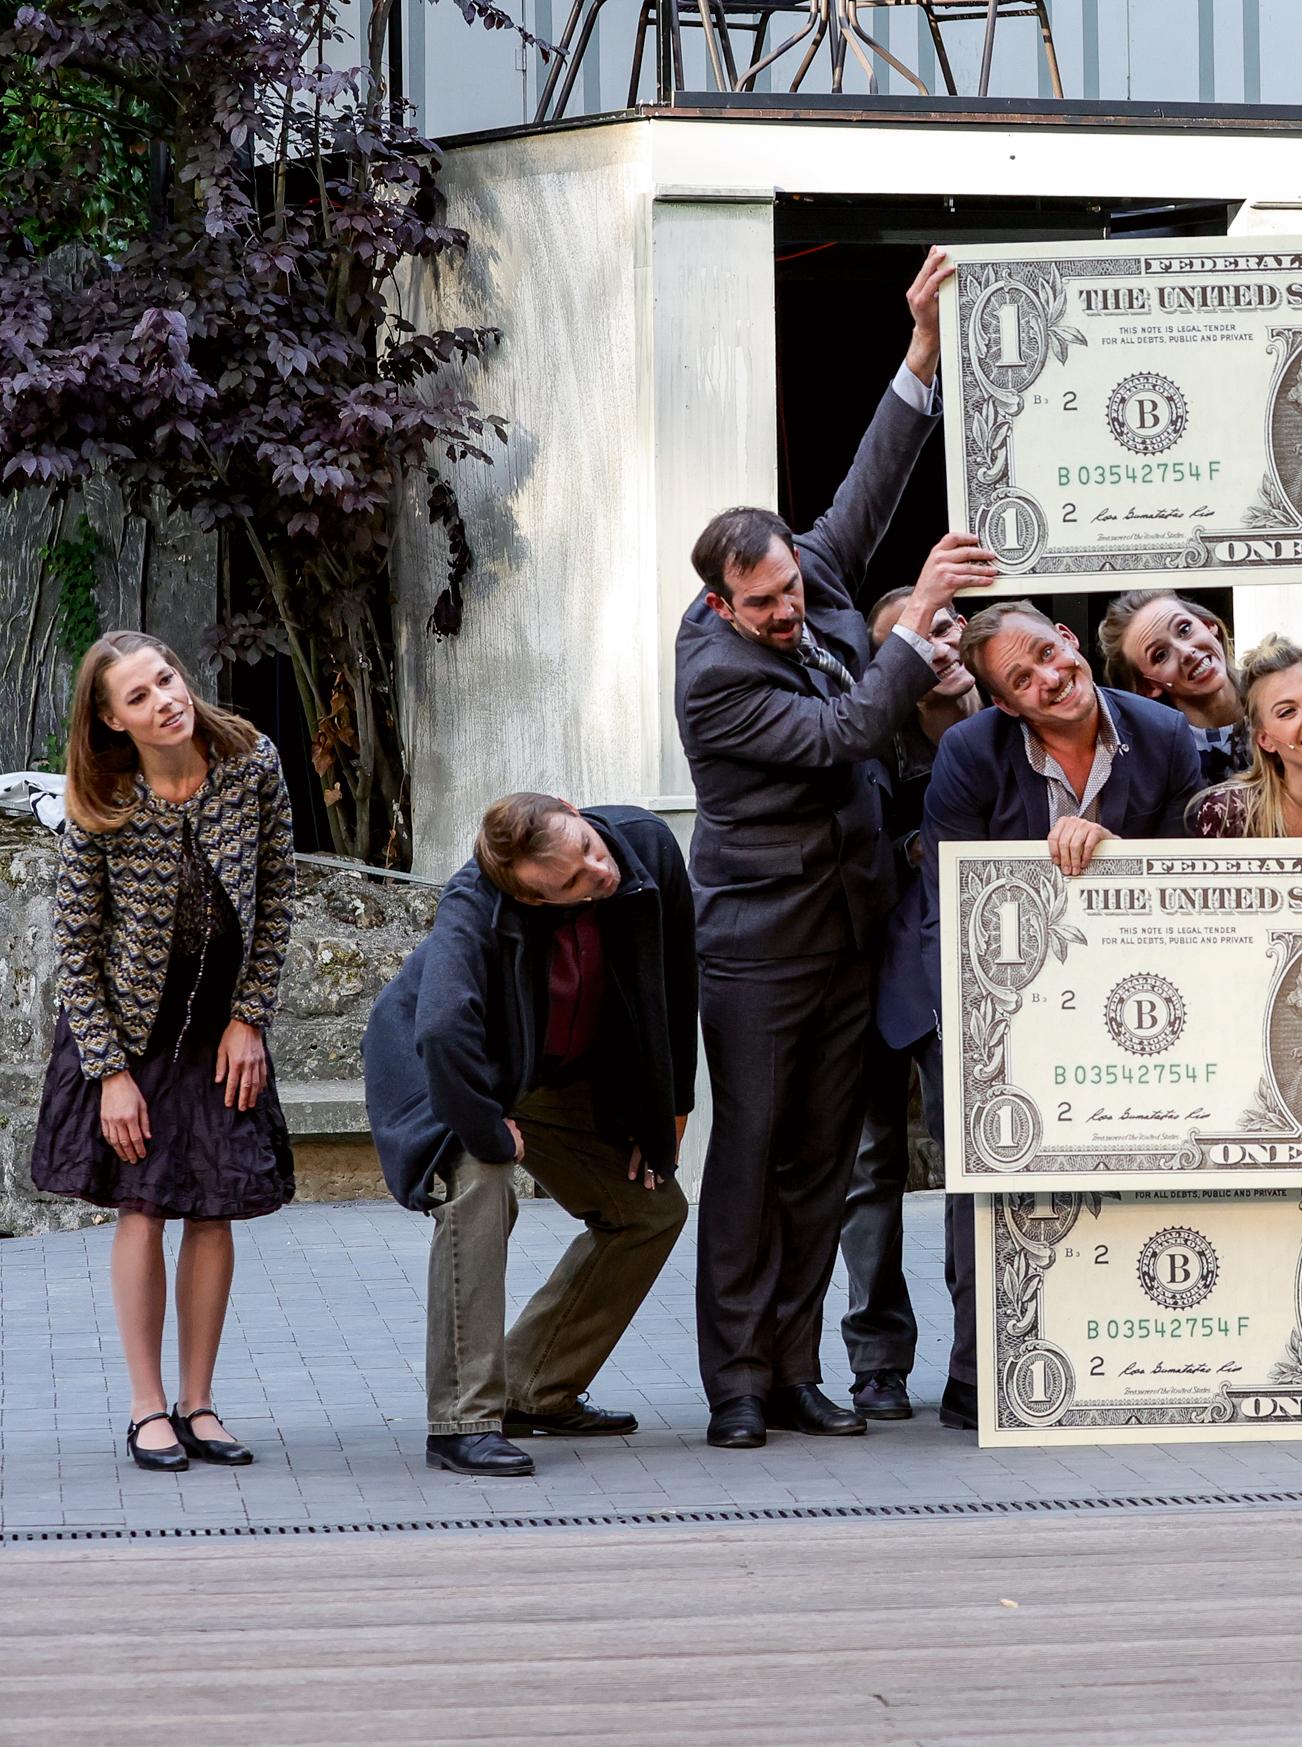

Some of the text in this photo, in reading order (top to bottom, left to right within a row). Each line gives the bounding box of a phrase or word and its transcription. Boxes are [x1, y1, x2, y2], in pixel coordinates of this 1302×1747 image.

[1148, 253, 1302, 275] FEDERAL
[1078, 287, 1151, 318] THE
[1157, 282, 1283, 315] UNITED
[993, 302, 1026, 368] 1
[1101, 332, 1254, 346] FOR ALL DEBTS, PUBLIC AND PRIVATE
[1118, 322, 1237, 335] THIS NOTE IS LEGAL TENDER
[1061, 390, 1078, 411] 2
[1134, 397, 1161, 429] B
[1061, 502, 1078, 523] 2
[998, 507, 1025, 550] 1
[1079, 887, 1152, 917] THE
[1158, 885, 1284, 916] UNITED
[993, 901, 1025, 966] 1
[1119, 925, 1237, 935] THIS NOTE IS LEGAL TENDER
[1101, 935, 1254, 947] FOR ALL DEBTS, PUBLIC AND PRIVATE
[1060, 990, 1076, 1010] 2
[1132, 998, 1158, 1030] B
[1056, 1101, 1073, 1122] 2
[994, 1105, 1019, 1148] 1
[1134, 1187, 1287, 1201] FOR ALL DEBTS, PUBLIC AND PRIVATE
[1093, 1244, 1109, 1265] 2
[1165, 1252, 1191, 1284] B
[1089, 1356, 1105, 1376] 2
[1027, 1360, 1052, 1403] 1
